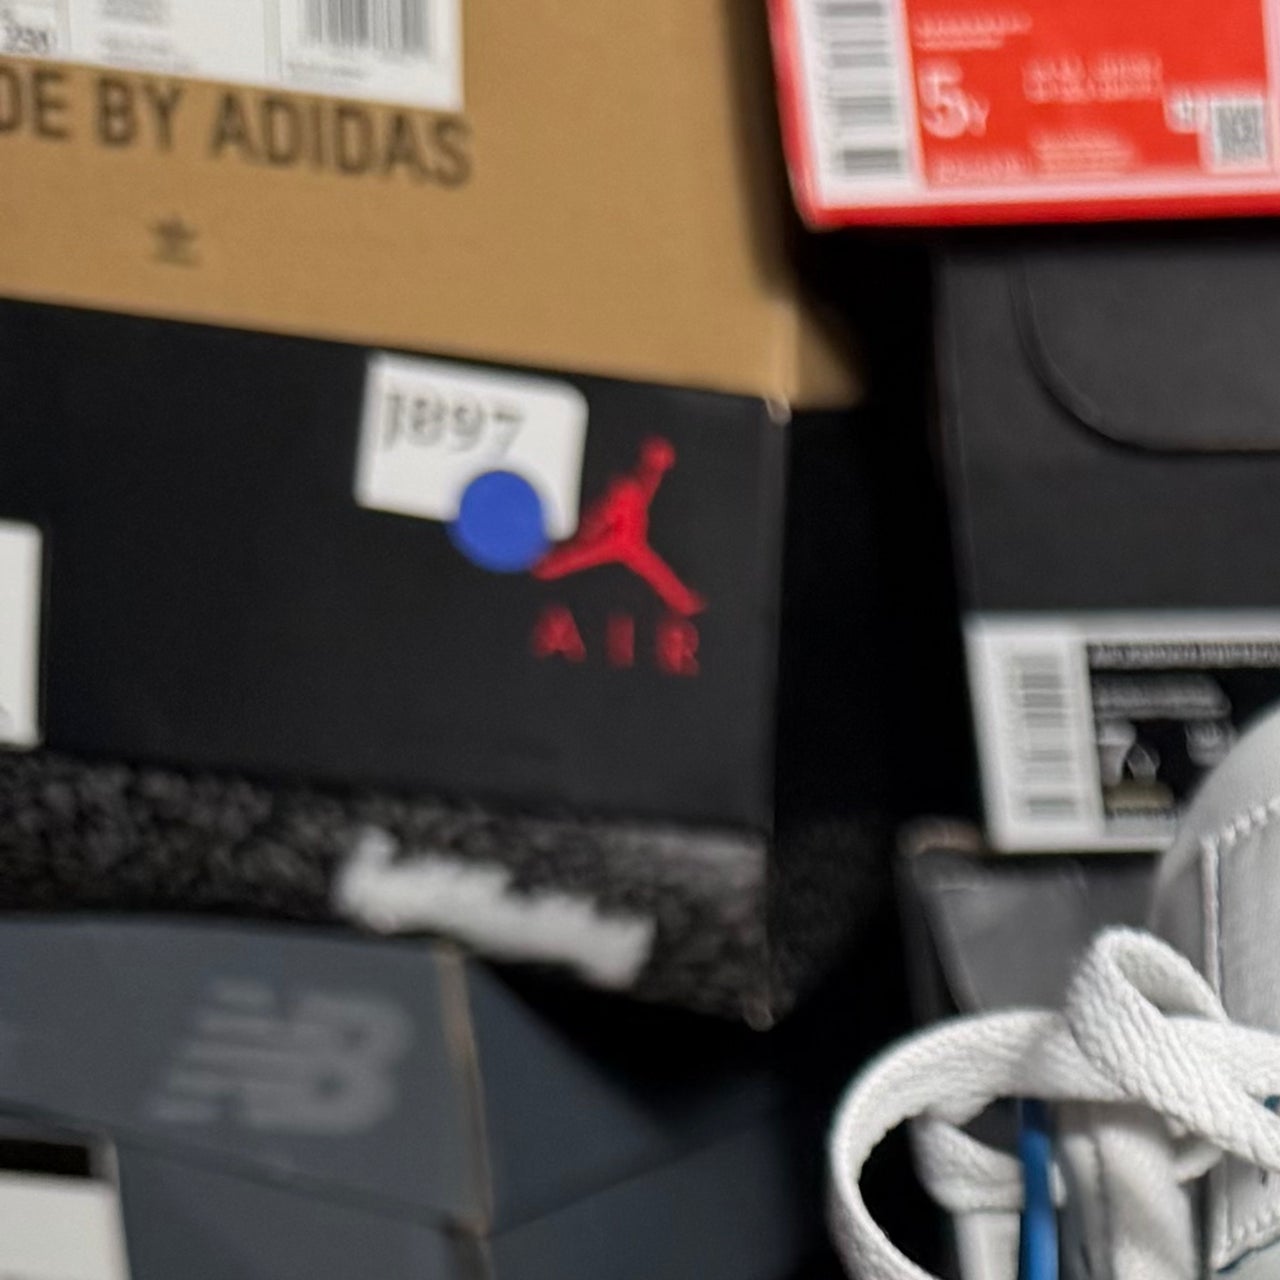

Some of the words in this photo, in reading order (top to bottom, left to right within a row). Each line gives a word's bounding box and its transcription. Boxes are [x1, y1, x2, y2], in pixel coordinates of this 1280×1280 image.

[95, 75, 182, 150] BY
[209, 92, 470, 188] ADIDAS
[534, 605, 700, 676] AIR
